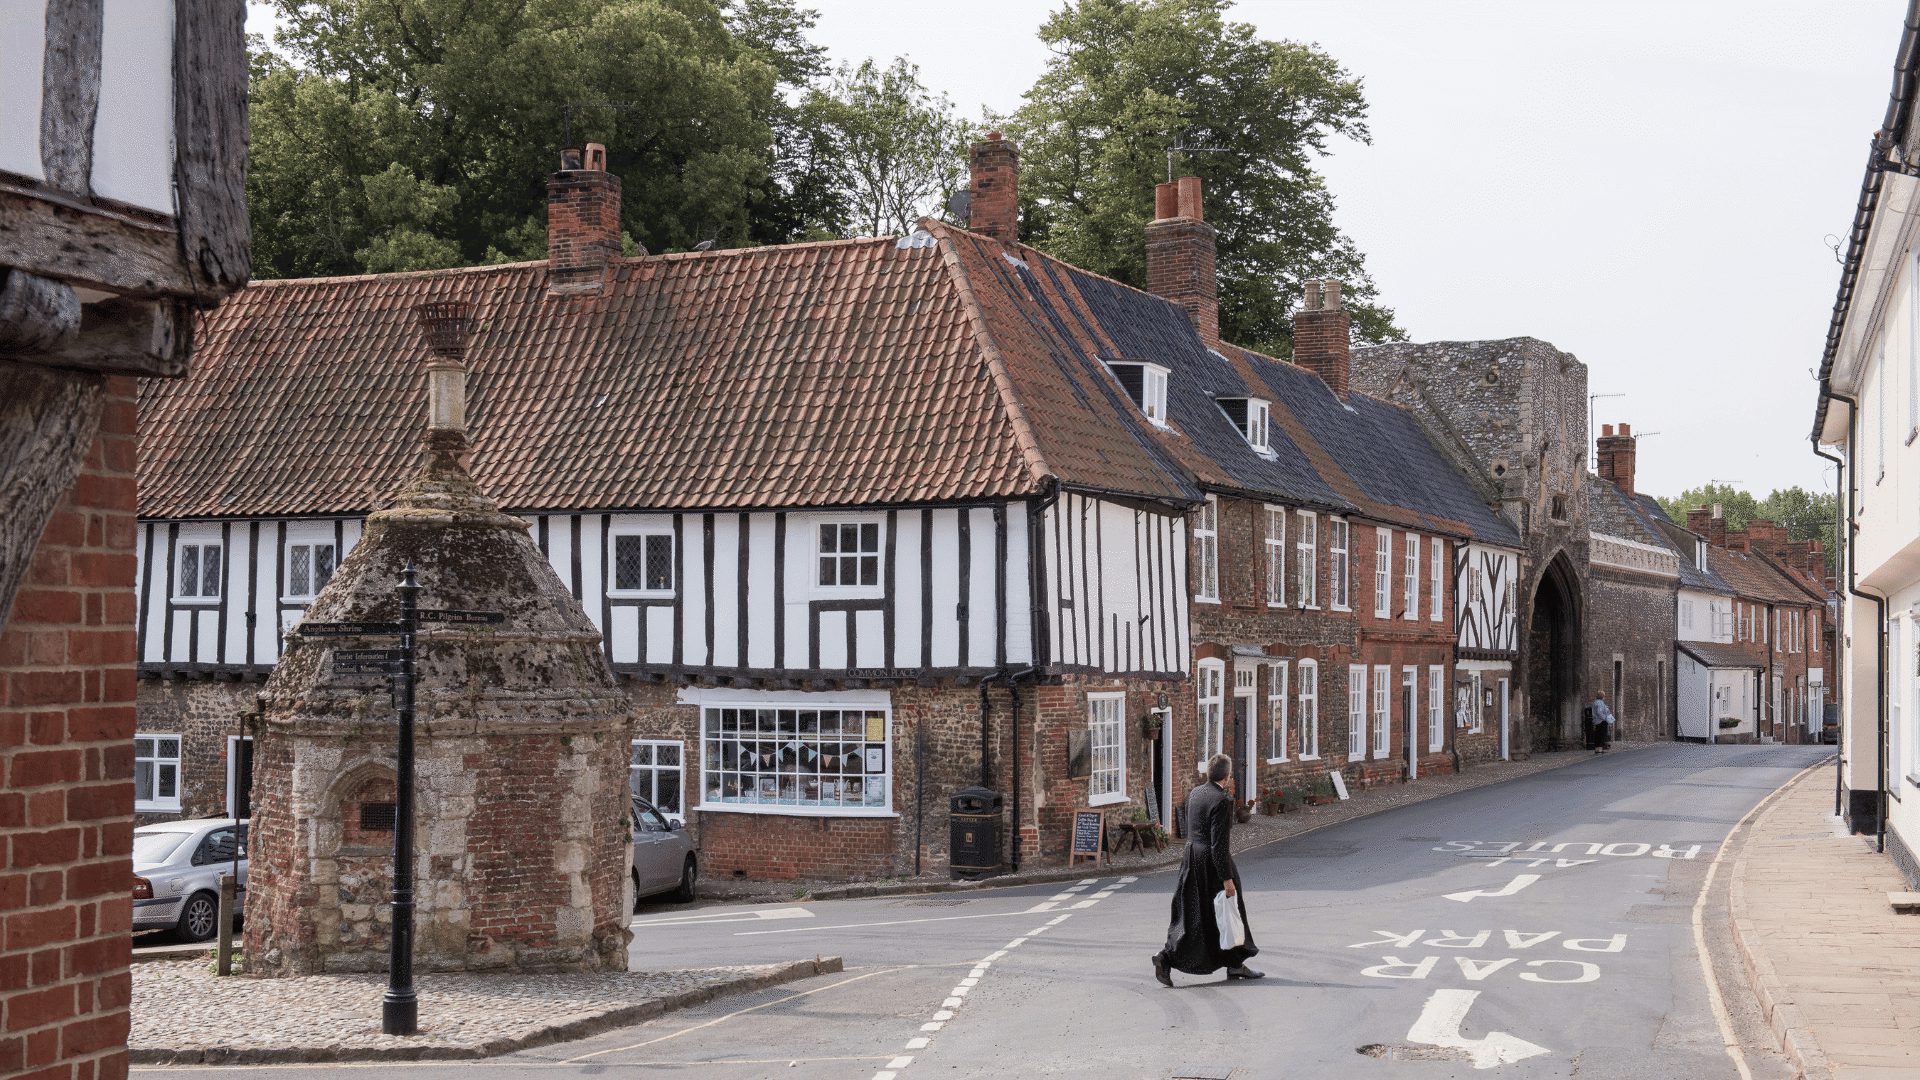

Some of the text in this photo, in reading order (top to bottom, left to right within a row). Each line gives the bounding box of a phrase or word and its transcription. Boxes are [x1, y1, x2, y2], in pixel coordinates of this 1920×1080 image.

[420, 611, 436, 620] R.C.
[439, 612, 462, 622] Pilgrim
[304, 624, 362, 634] Anglican Shrine
[848, 668, 915, 678] COMMON PLACE
[1432, 841, 1702, 859] ROUTES
[1473, 857, 1599, 868] ALL
[1348, 929, 1628, 953] PARK
[1360, 956, 1601, 984] CAR
